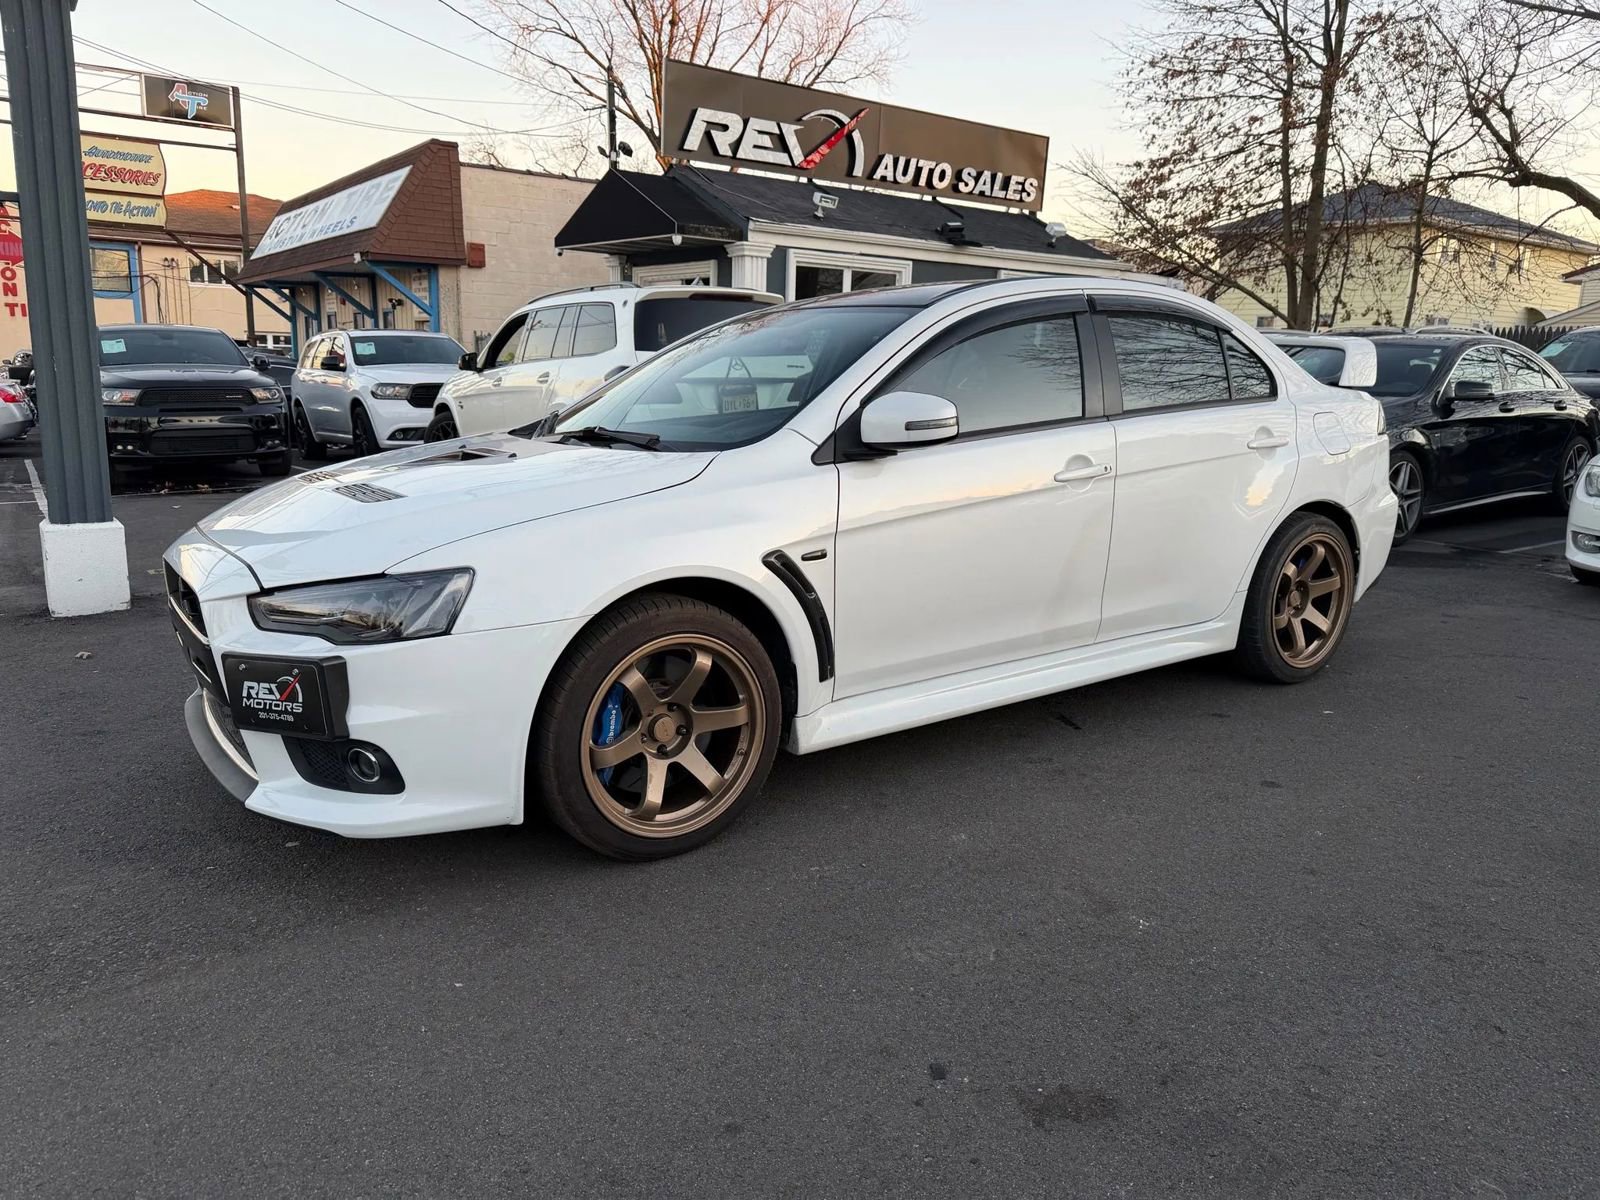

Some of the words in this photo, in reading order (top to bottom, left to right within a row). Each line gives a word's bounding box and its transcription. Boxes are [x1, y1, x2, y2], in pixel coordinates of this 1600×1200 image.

[683, 107, 869, 169] REV
[82, 160, 162, 186] CESSORIES
[873, 153, 952, 190] AUTO
[958, 167, 1038, 203] SALES
[308, 216, 357, 240] WHEELS
[242, 673, 301, 701] REV
[242, 698, 303, 713] MOTORS
[608, 710, 617, 736] brembo
